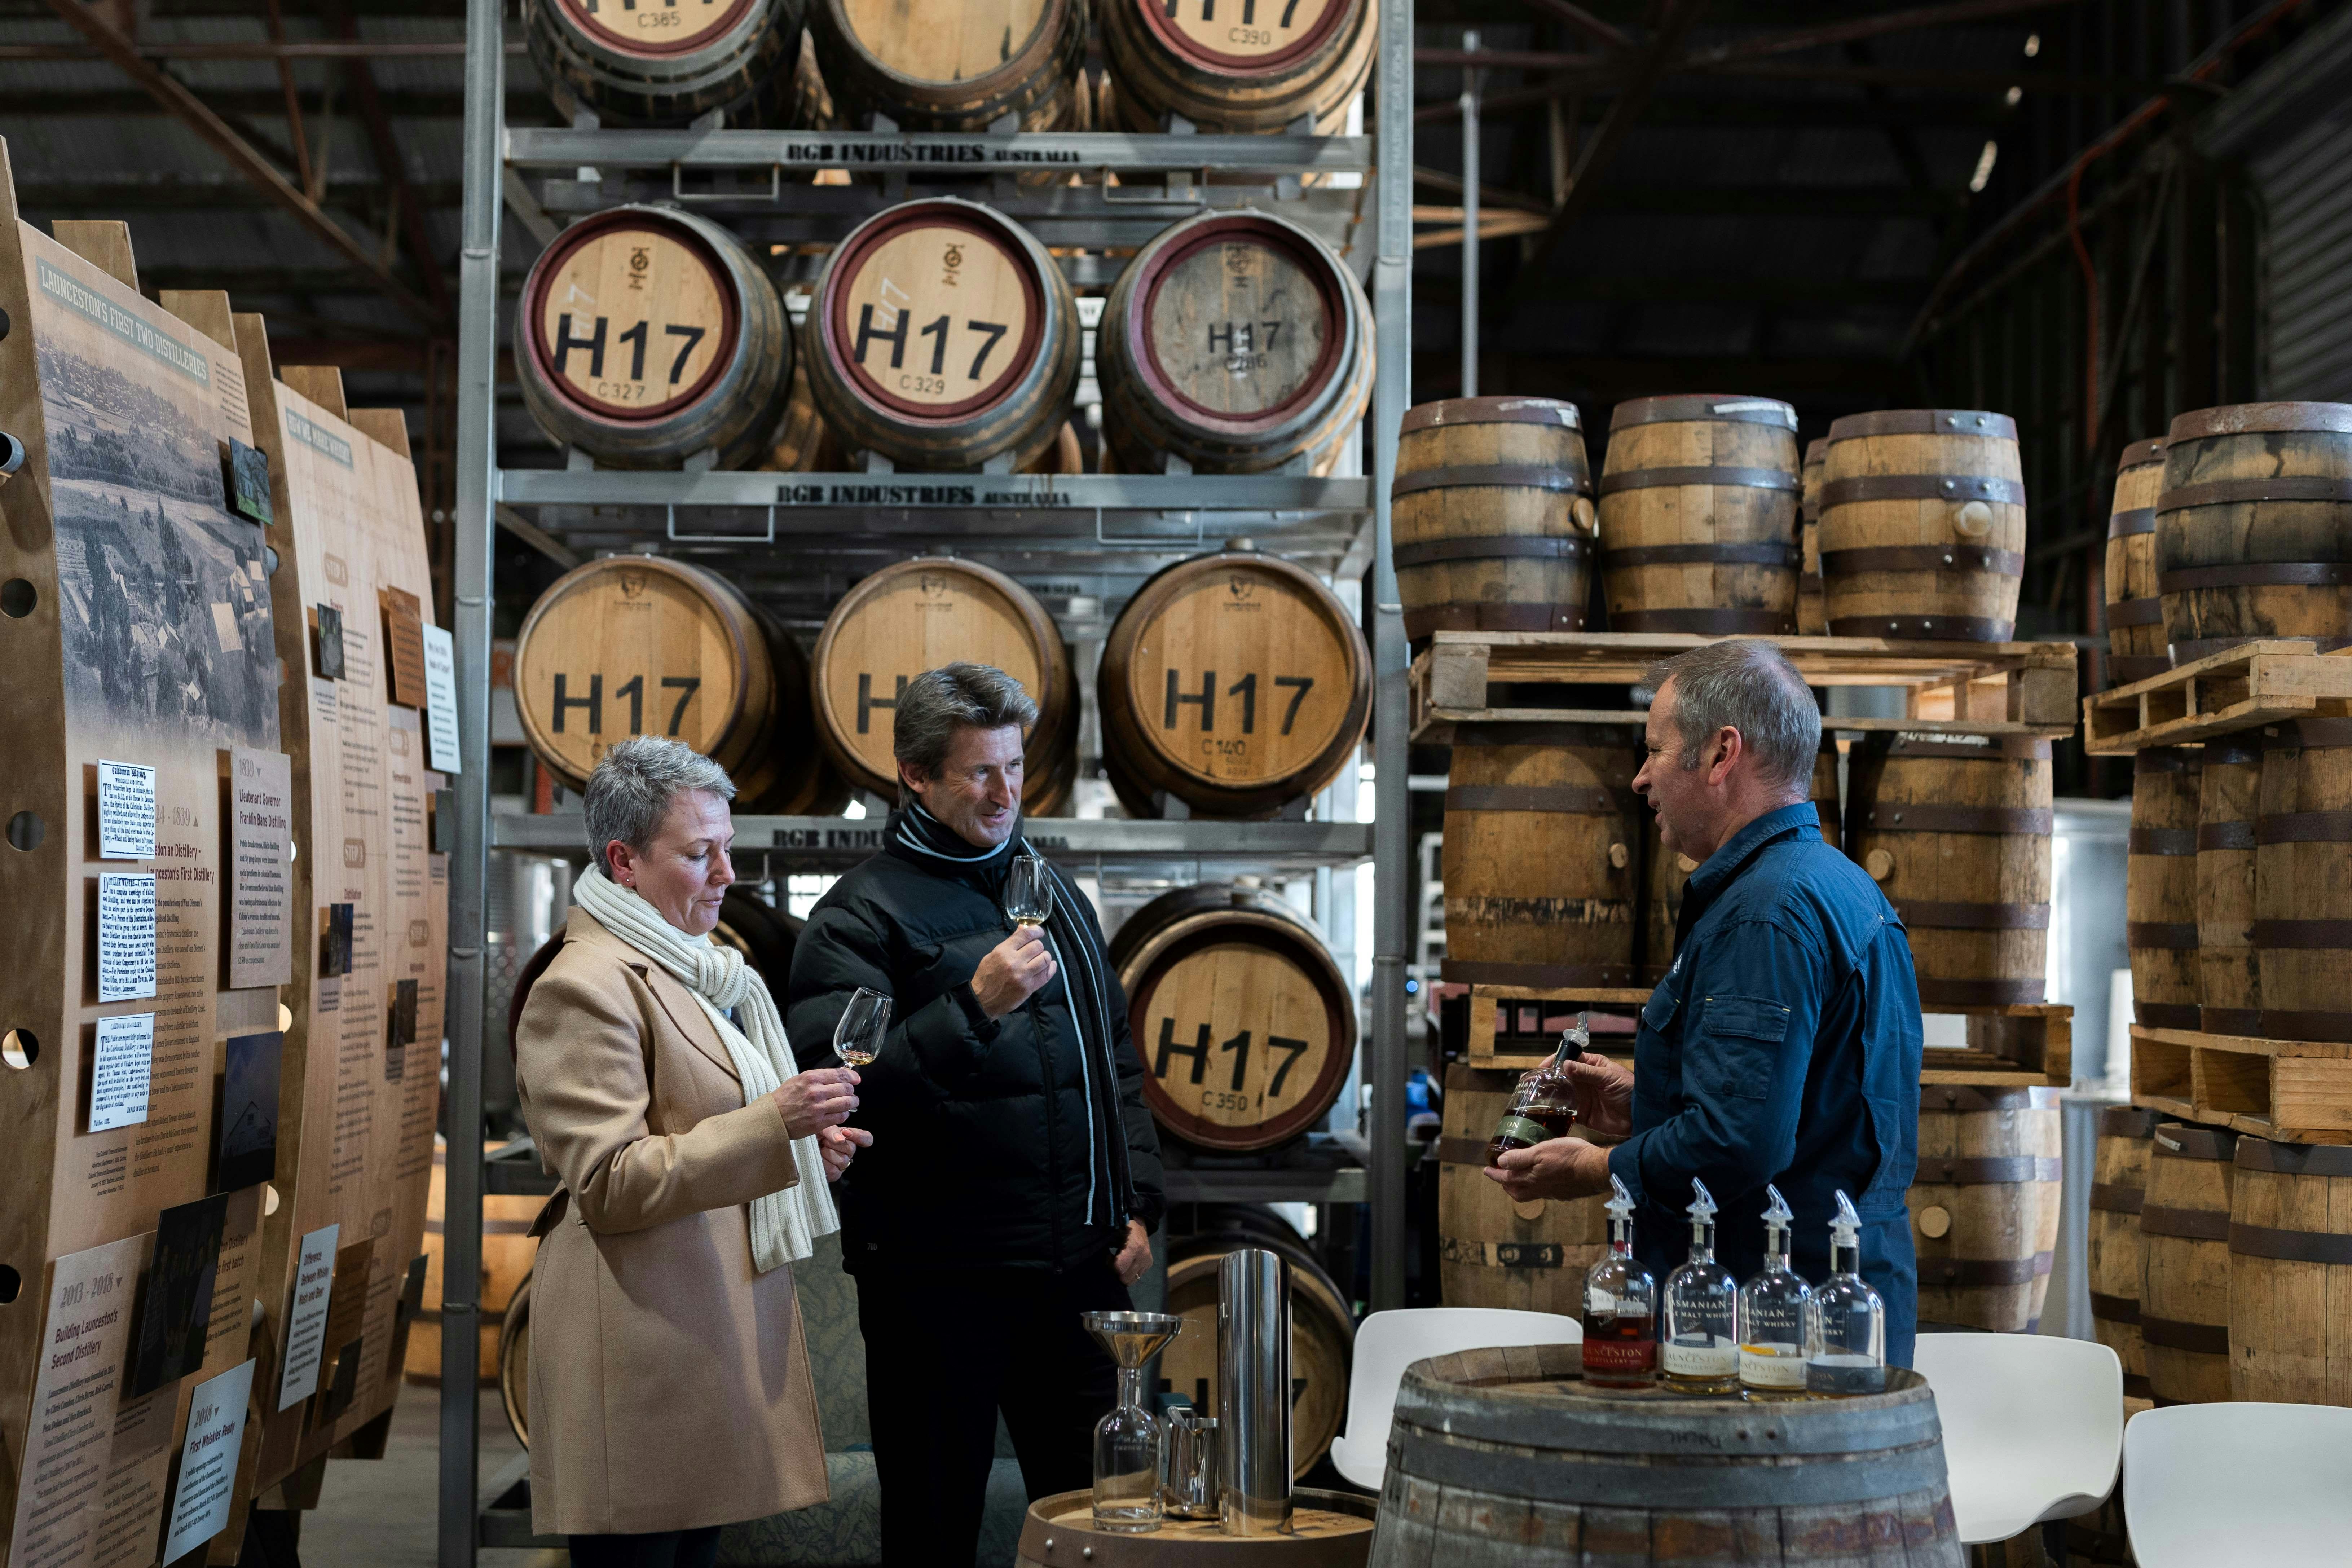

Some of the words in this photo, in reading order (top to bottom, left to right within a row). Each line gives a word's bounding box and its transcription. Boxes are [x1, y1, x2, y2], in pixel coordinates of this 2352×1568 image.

[638, 11, 680, 28] C385
[1229, 27, 1270, 45] C390
[840, 145, 985, 162] INDUSTRIES
[992, 150, 1080, 162] AUSTRALIA
[41, 266, 108, 323] LAUNCESTON'S
[110, 306, 134, 338] FIRST
[136, 323, 153, 349] TWO
[156, 333, 206, 380] DISTILLERIES
[854, 303, 1007, 380] H17
[1207, 322, 1281, 353] H17
[554, 313, 705, 383] H17
[830, 486, 974, 504] INDUSTRIES
[982, 492, 1070, 505] AUSTRALIA
[552, 673, 700, 736] H17
[1164, 669, 1314, 735] H17
[239, 758, 254, 778] 1839
[239, 789, 261, 804] Lieutenant
[263, 793, 281, 807] Governor
[173, 807, 190, 826] 1839
[240, 811, 256, 825] Franklin
[257, 813, 267, 827] Bans
[269, 815, 286, 831] Distilling
[155, 842, 173, 856] edonian
[175, 843, 197, 861] Distillery
[181, 867, 192, 881] First
[194, 867, 214, 884] Distillery
[247, 869, 257, 878] problems
[171, 898, 180, 909] colony
[172, 929, 181, 939] whisky
[1155, 1017, 1308, 1097] H17
[1202, 1090, 1247, 1111] C350
[60, 1282, 84, 1308] 2013
[91, 1272, 114, 1298] 2018
[55, 1323, 80, 1344] Building
[81, 1308, 118, 1335] Launceston's
[51, 1348, 75, 1369] Second
[75, 1339, 102, 1361] Distillery
[194, 1404, 213, 1428] 2018
[189, 1438, 201, 1455] First
[202, 1429, 221, 1449] Whiskies
[221, 1420, 235, 1437] Ready
